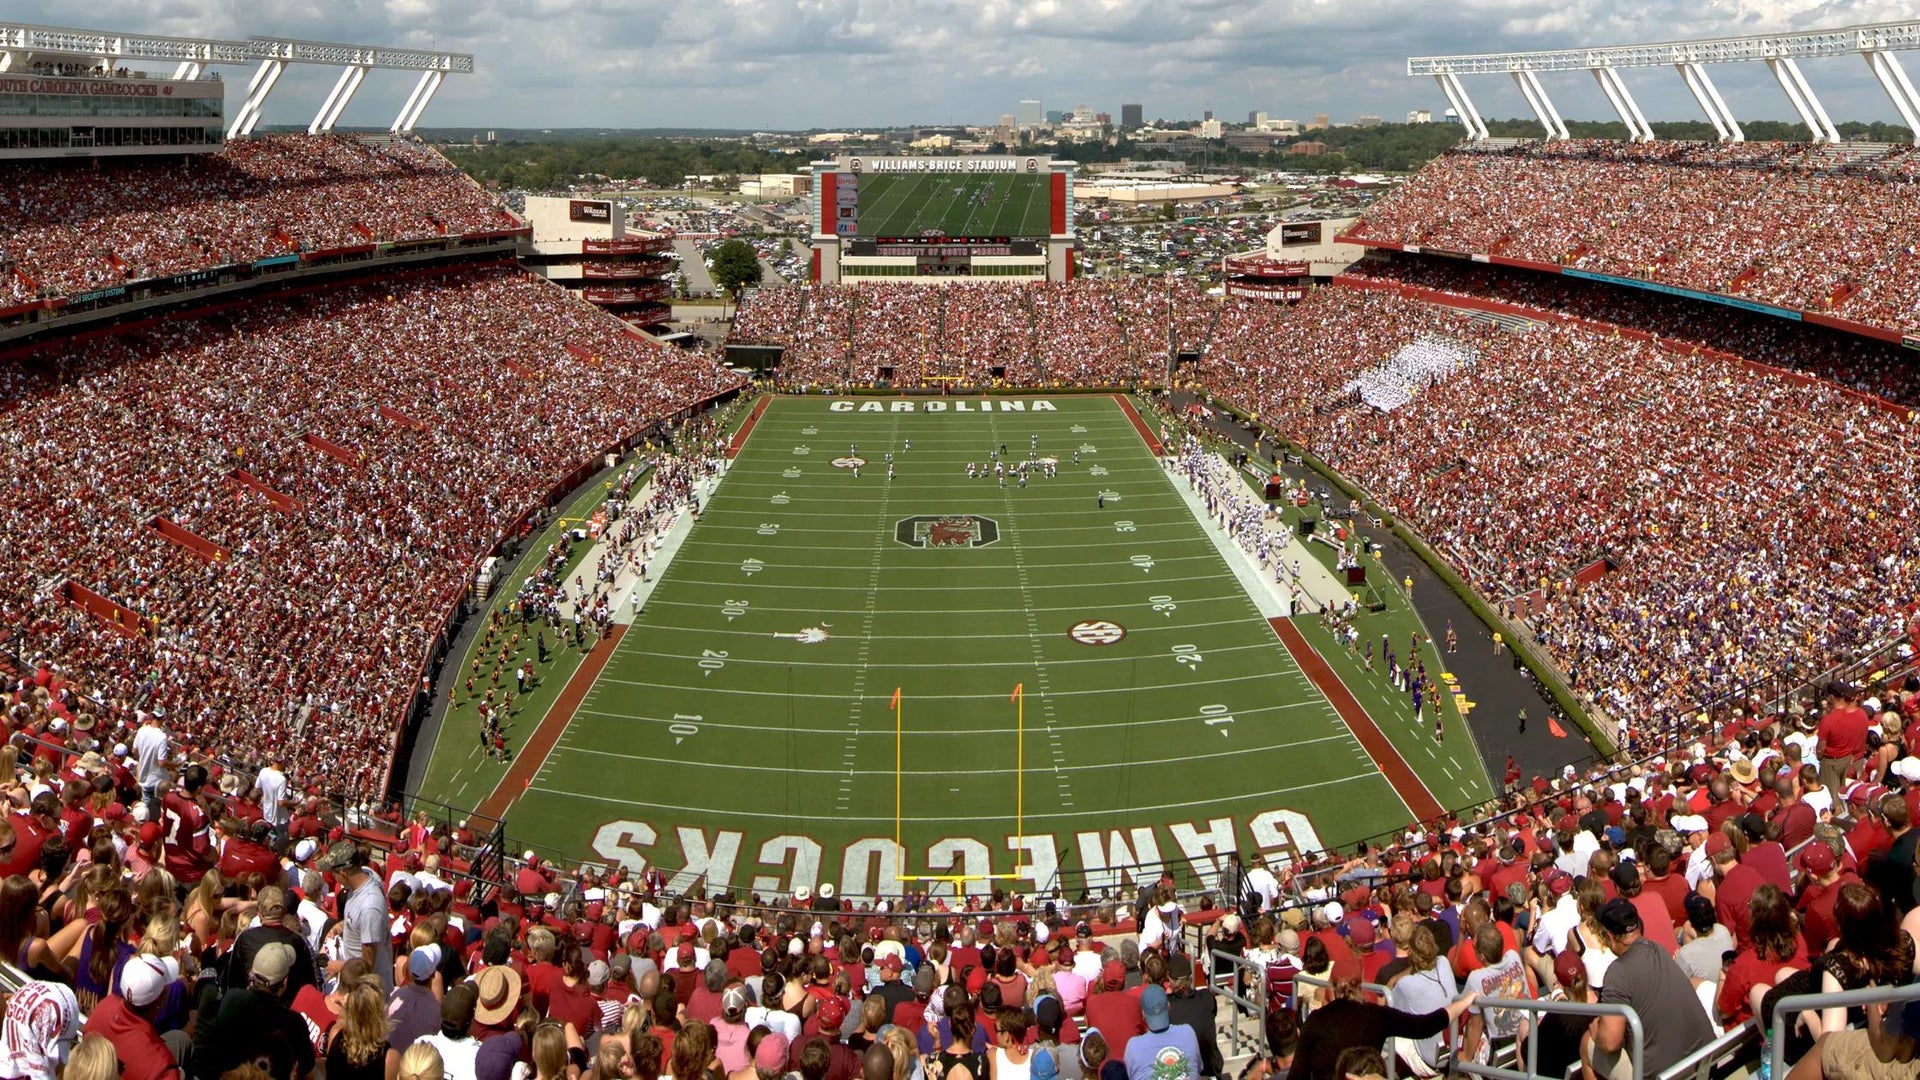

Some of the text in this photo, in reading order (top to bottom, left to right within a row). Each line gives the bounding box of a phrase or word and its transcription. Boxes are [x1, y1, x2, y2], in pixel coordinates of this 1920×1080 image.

[29, 80, 88, 95] CAROLINA
[90, 82, 158, 96] GAMECOCKS
[871, 160, 1017, 171] WILLIAMS-BRICE STADIUM
[829, 400, 1058, 413] CAROLINA
[721, 599, 749, 616] 30
[1148, 595, 1176, 611] 30
[698, 649, 729, 669] 20
[1171, 644, 1203, 664] 20
[668, 713, 703, 735] 10
[1199, 704, 1235, 726] 10
[577, 808, 1327, 899] GAMECOCKS
